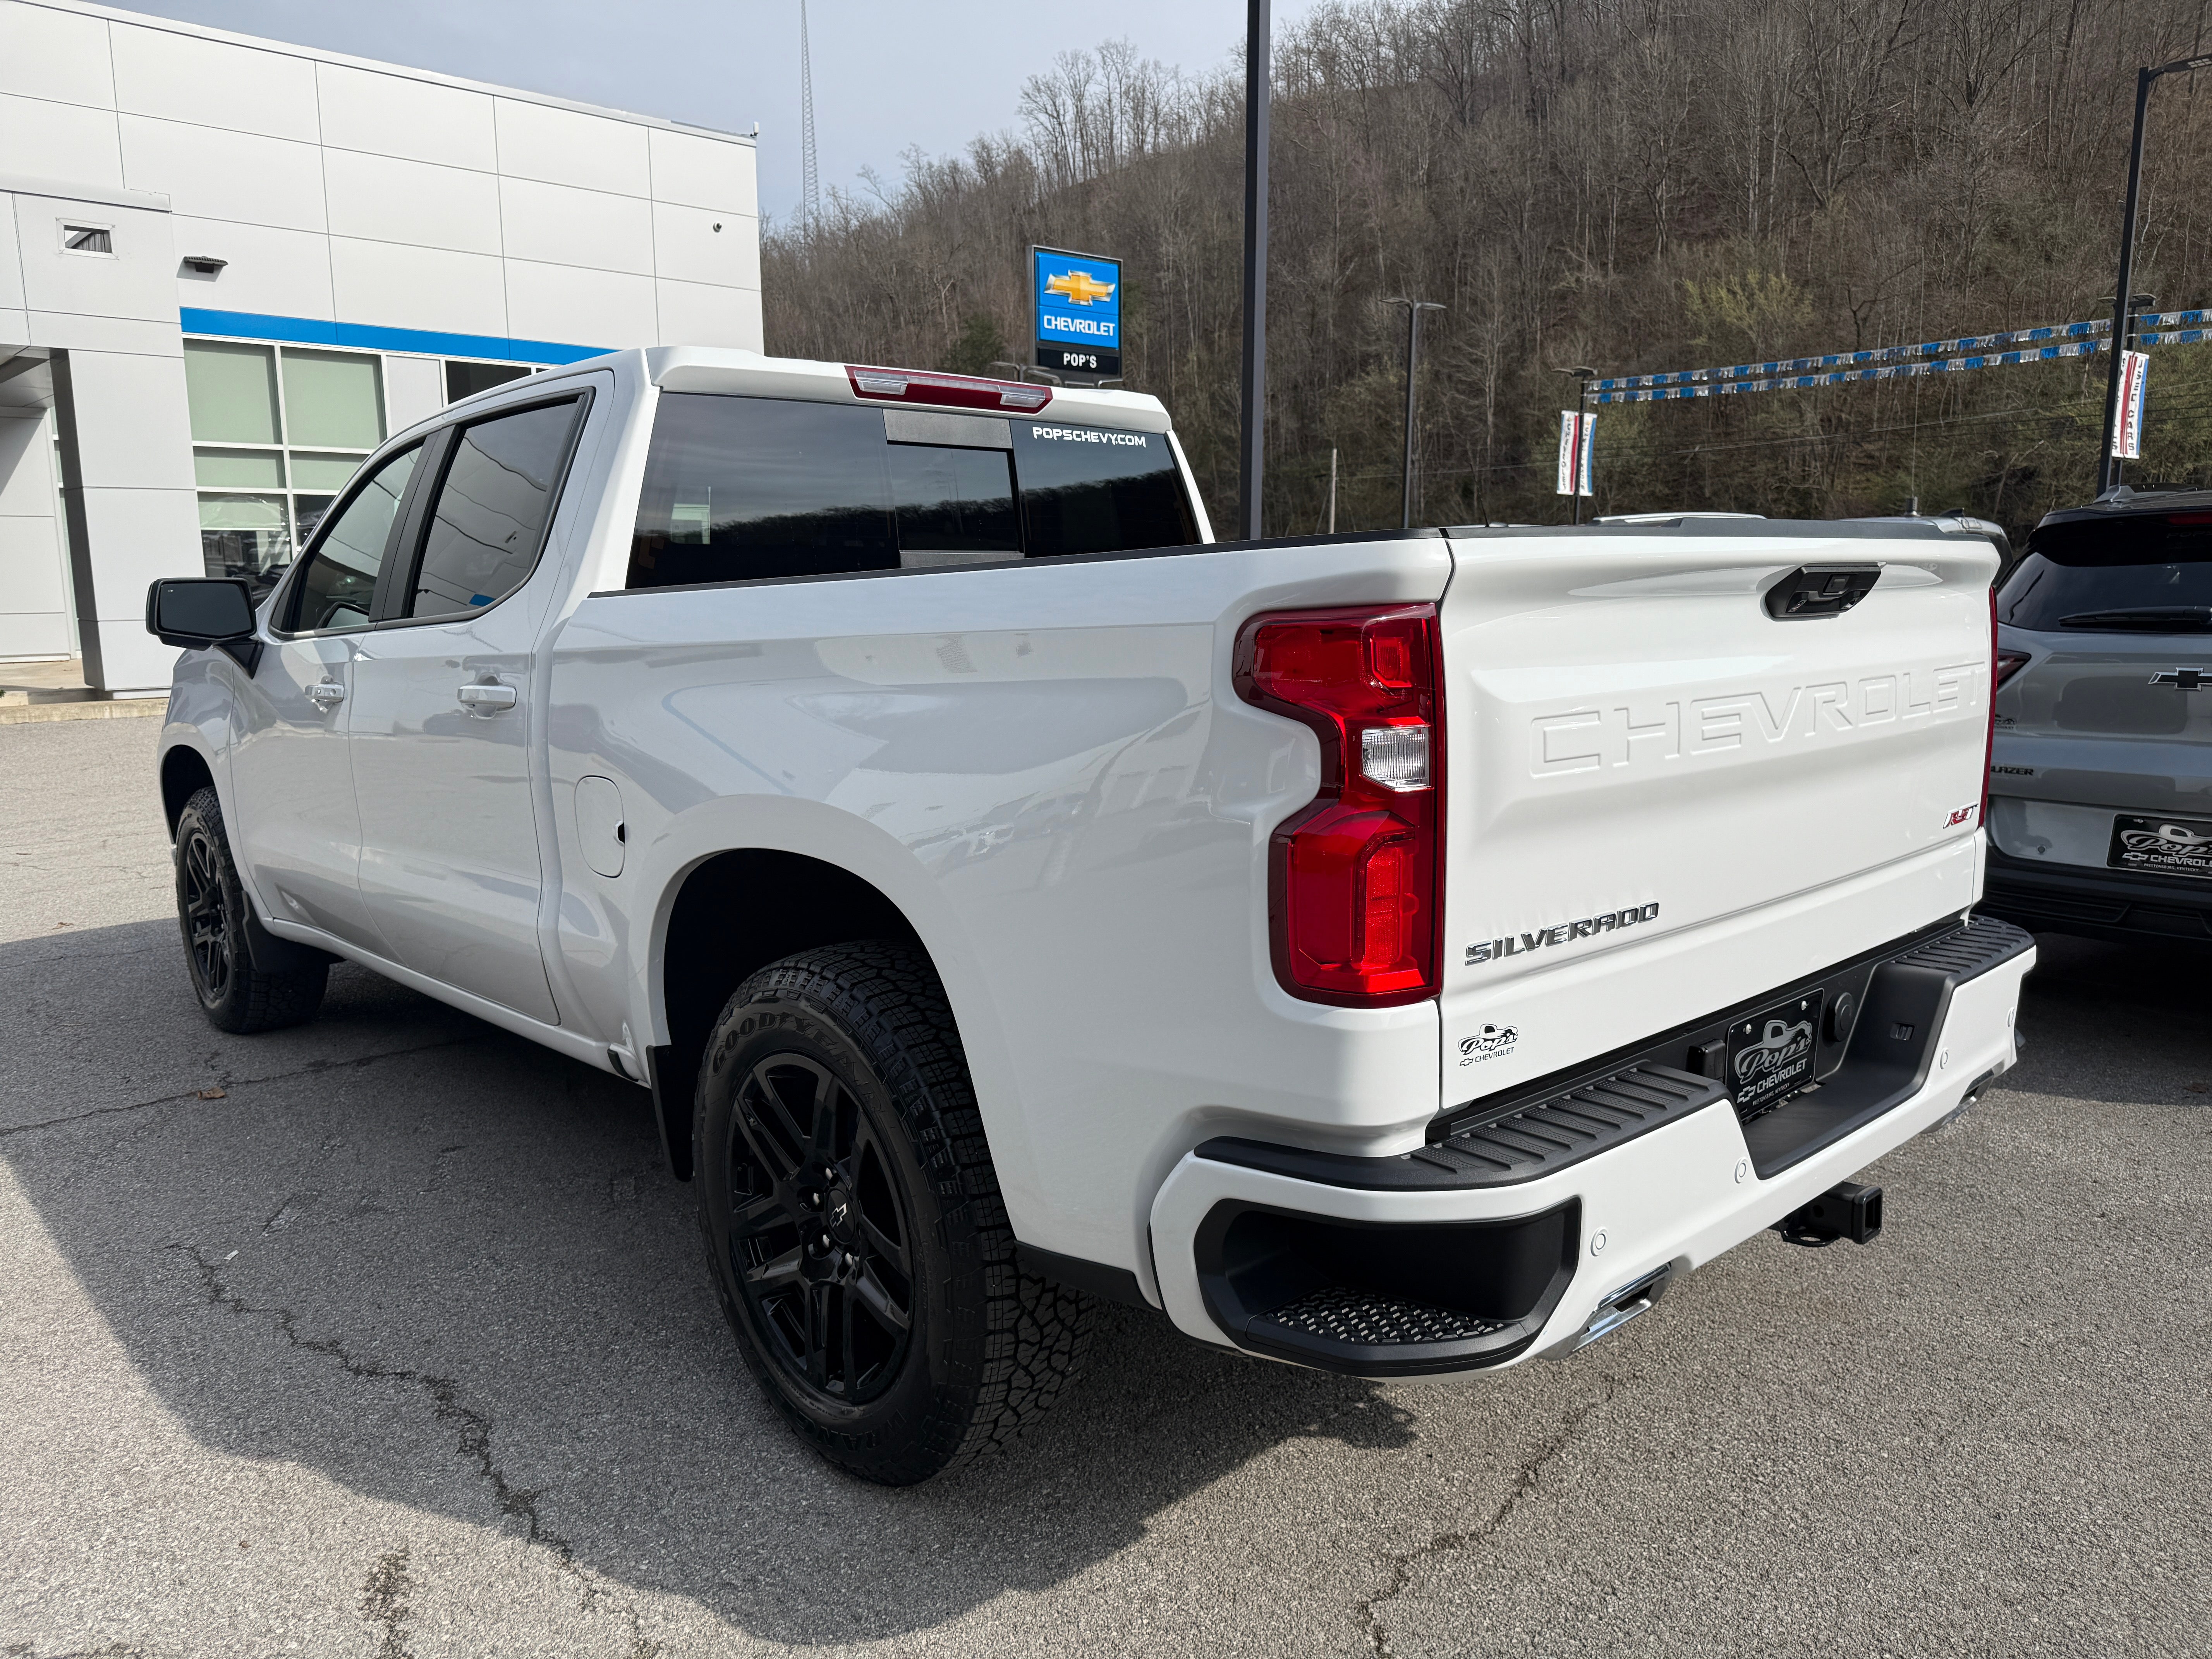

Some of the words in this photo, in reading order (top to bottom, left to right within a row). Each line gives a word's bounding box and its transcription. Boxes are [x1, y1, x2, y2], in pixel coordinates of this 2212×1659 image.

[1043, 315, 1116, 337] CHEVROLET
[1063, 352, 1097, 369] POP'S
[1032, 426, 1146, 448] POPSCHEVY.COM
[2127, 410, 2135, 450] CARS
[1530, 661, 1986, 778] CHEVROLET
[1991, 766, 2033, 775] LAZER
[1465, 900, 1659, 966] SILVERADO
[1475, 1047, 1515, 1063] CHEVROLET
[1757, 1058, 1807, 1094] CHEVROLET
